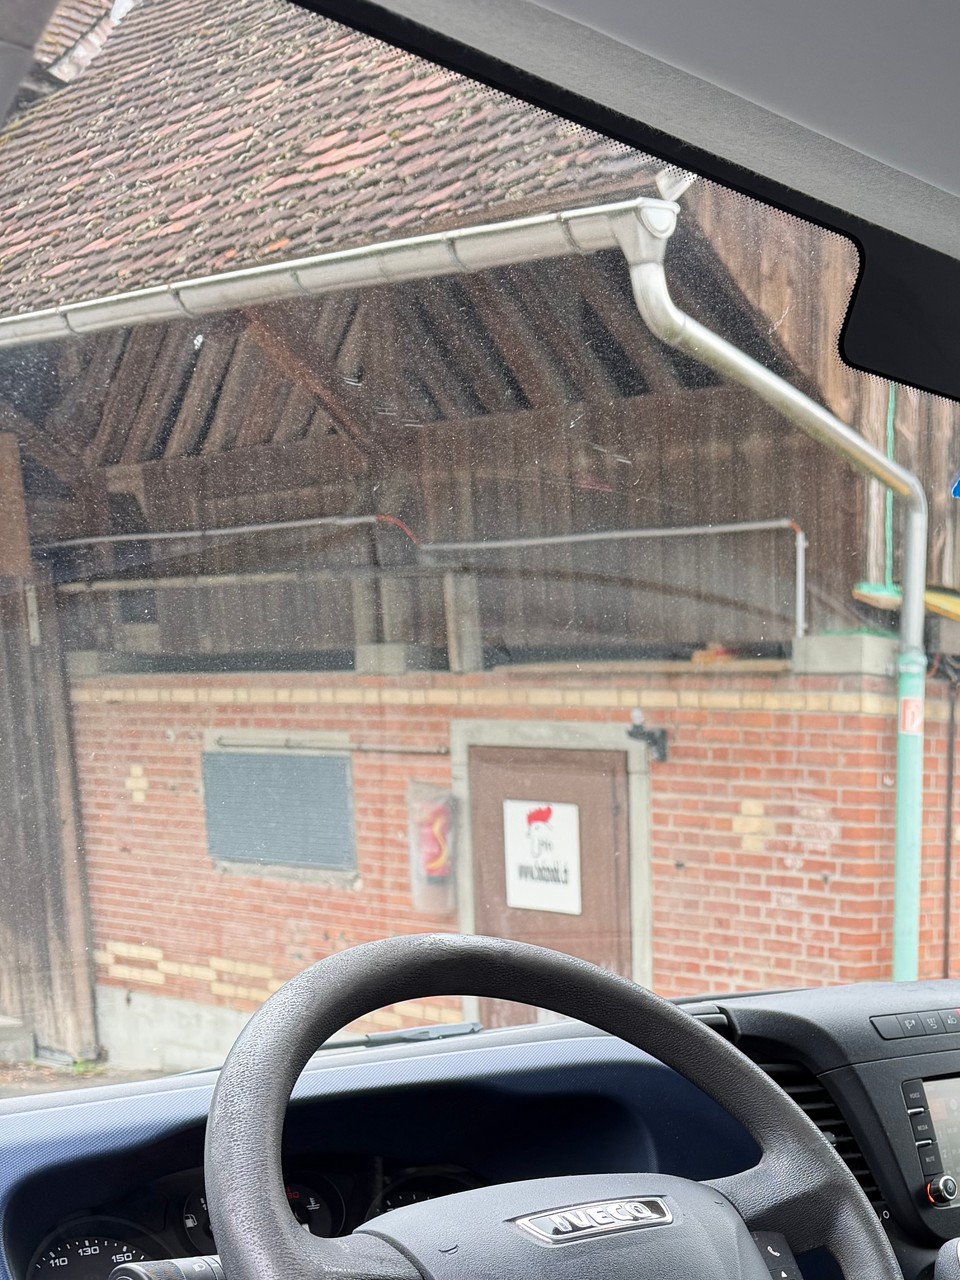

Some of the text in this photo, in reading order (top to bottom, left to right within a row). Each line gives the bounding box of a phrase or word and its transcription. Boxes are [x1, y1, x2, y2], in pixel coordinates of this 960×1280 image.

[549, 1201, 654, 1232] IVECO
[77, 1246, 100, 1257] 130
[49, 1257, 68, 1268] 110
[111, 1252, 133, 1263] 150
